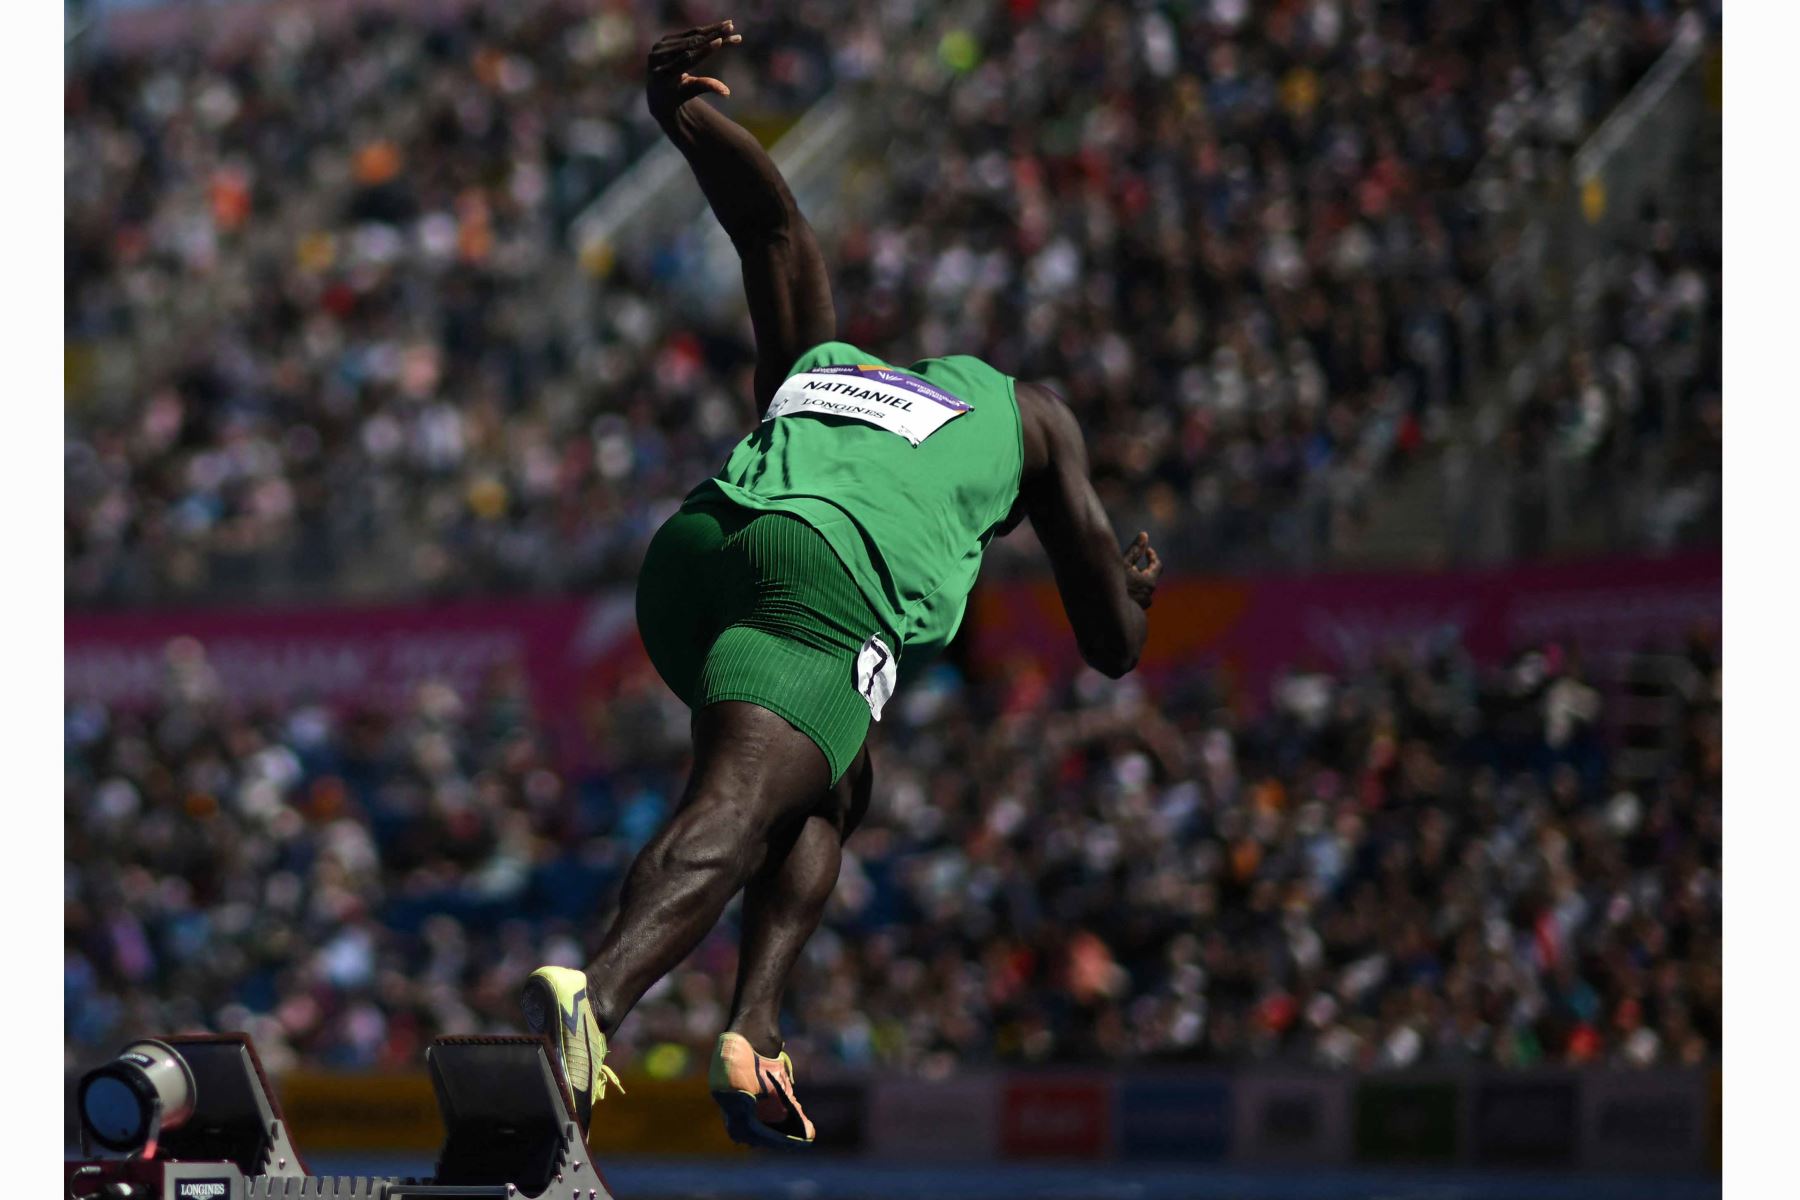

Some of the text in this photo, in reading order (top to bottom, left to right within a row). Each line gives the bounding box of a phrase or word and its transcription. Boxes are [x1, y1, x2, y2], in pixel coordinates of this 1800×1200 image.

[803, 380, 915, 413] NATHANIEL
[801, 397, 886, 420] LONGINES
[180, 1183, 225, 1196] LONGINES
